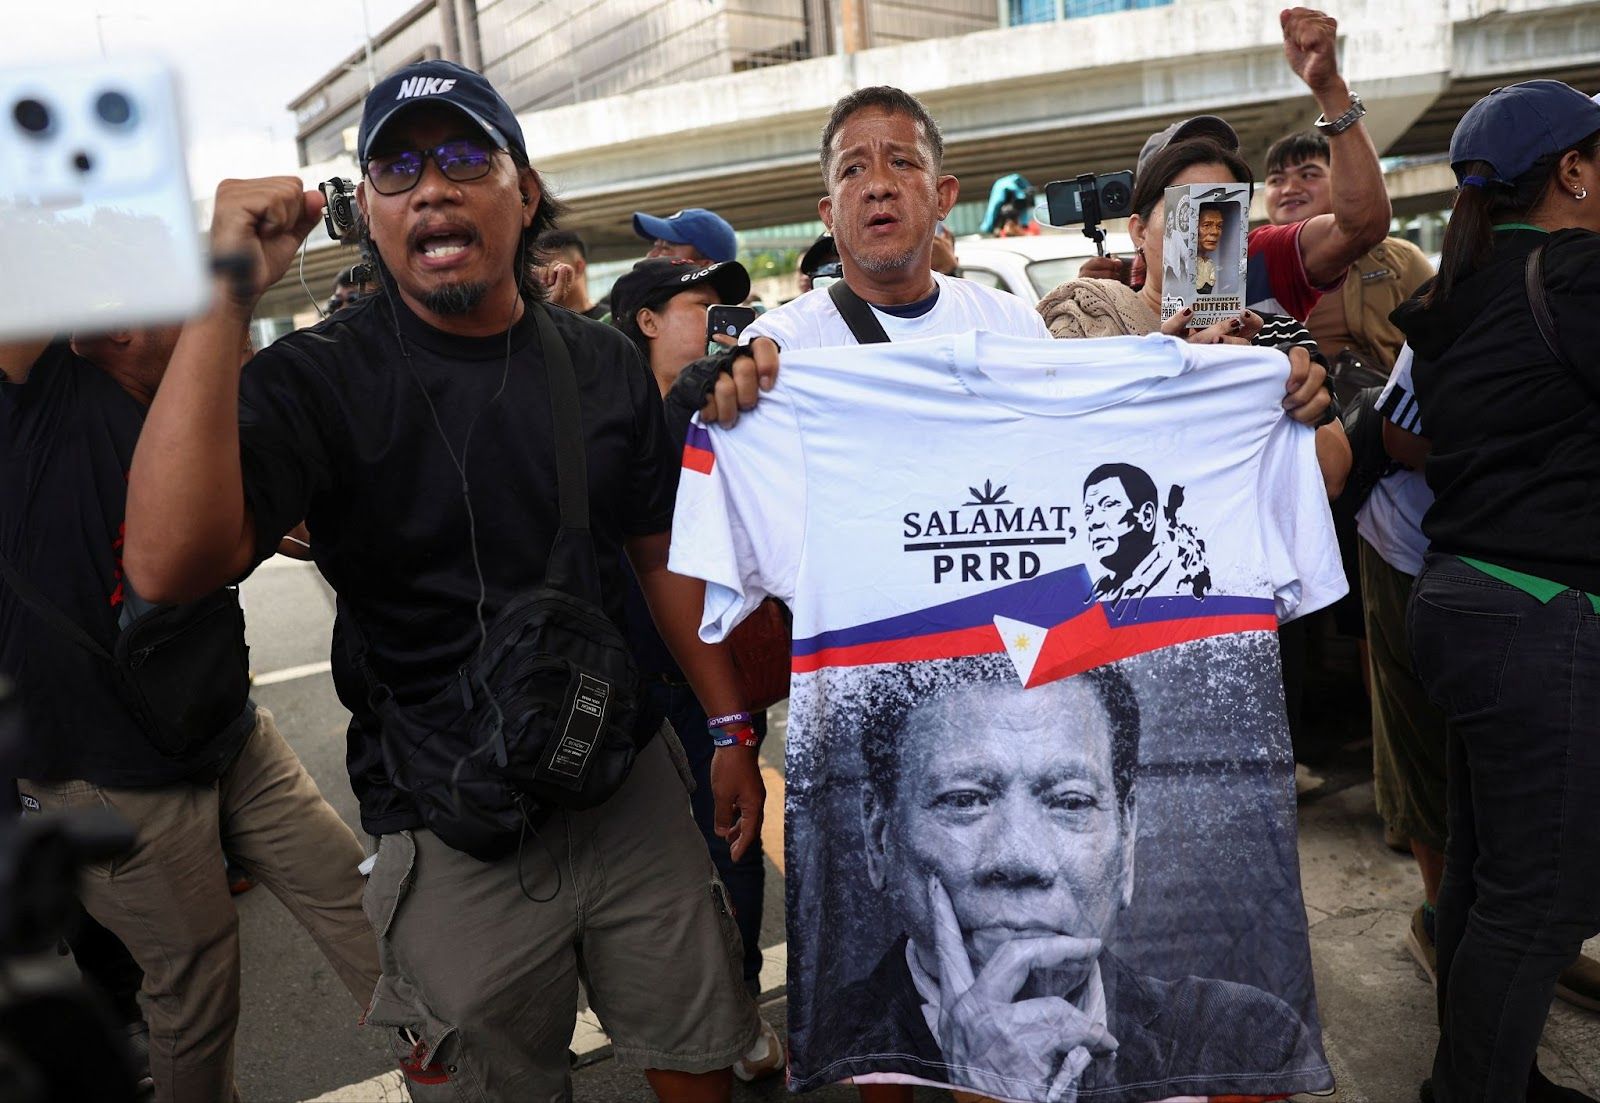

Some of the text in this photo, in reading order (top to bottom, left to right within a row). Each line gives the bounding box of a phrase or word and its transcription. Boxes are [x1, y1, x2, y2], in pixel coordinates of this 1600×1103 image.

[396, 76, 457, 100] NIKE
[1192, 302, 1241, 312] DUTERTE
[903, 506, 1077, 539] SALAMAT,
[934, 551, 1041, 584] PRRD
